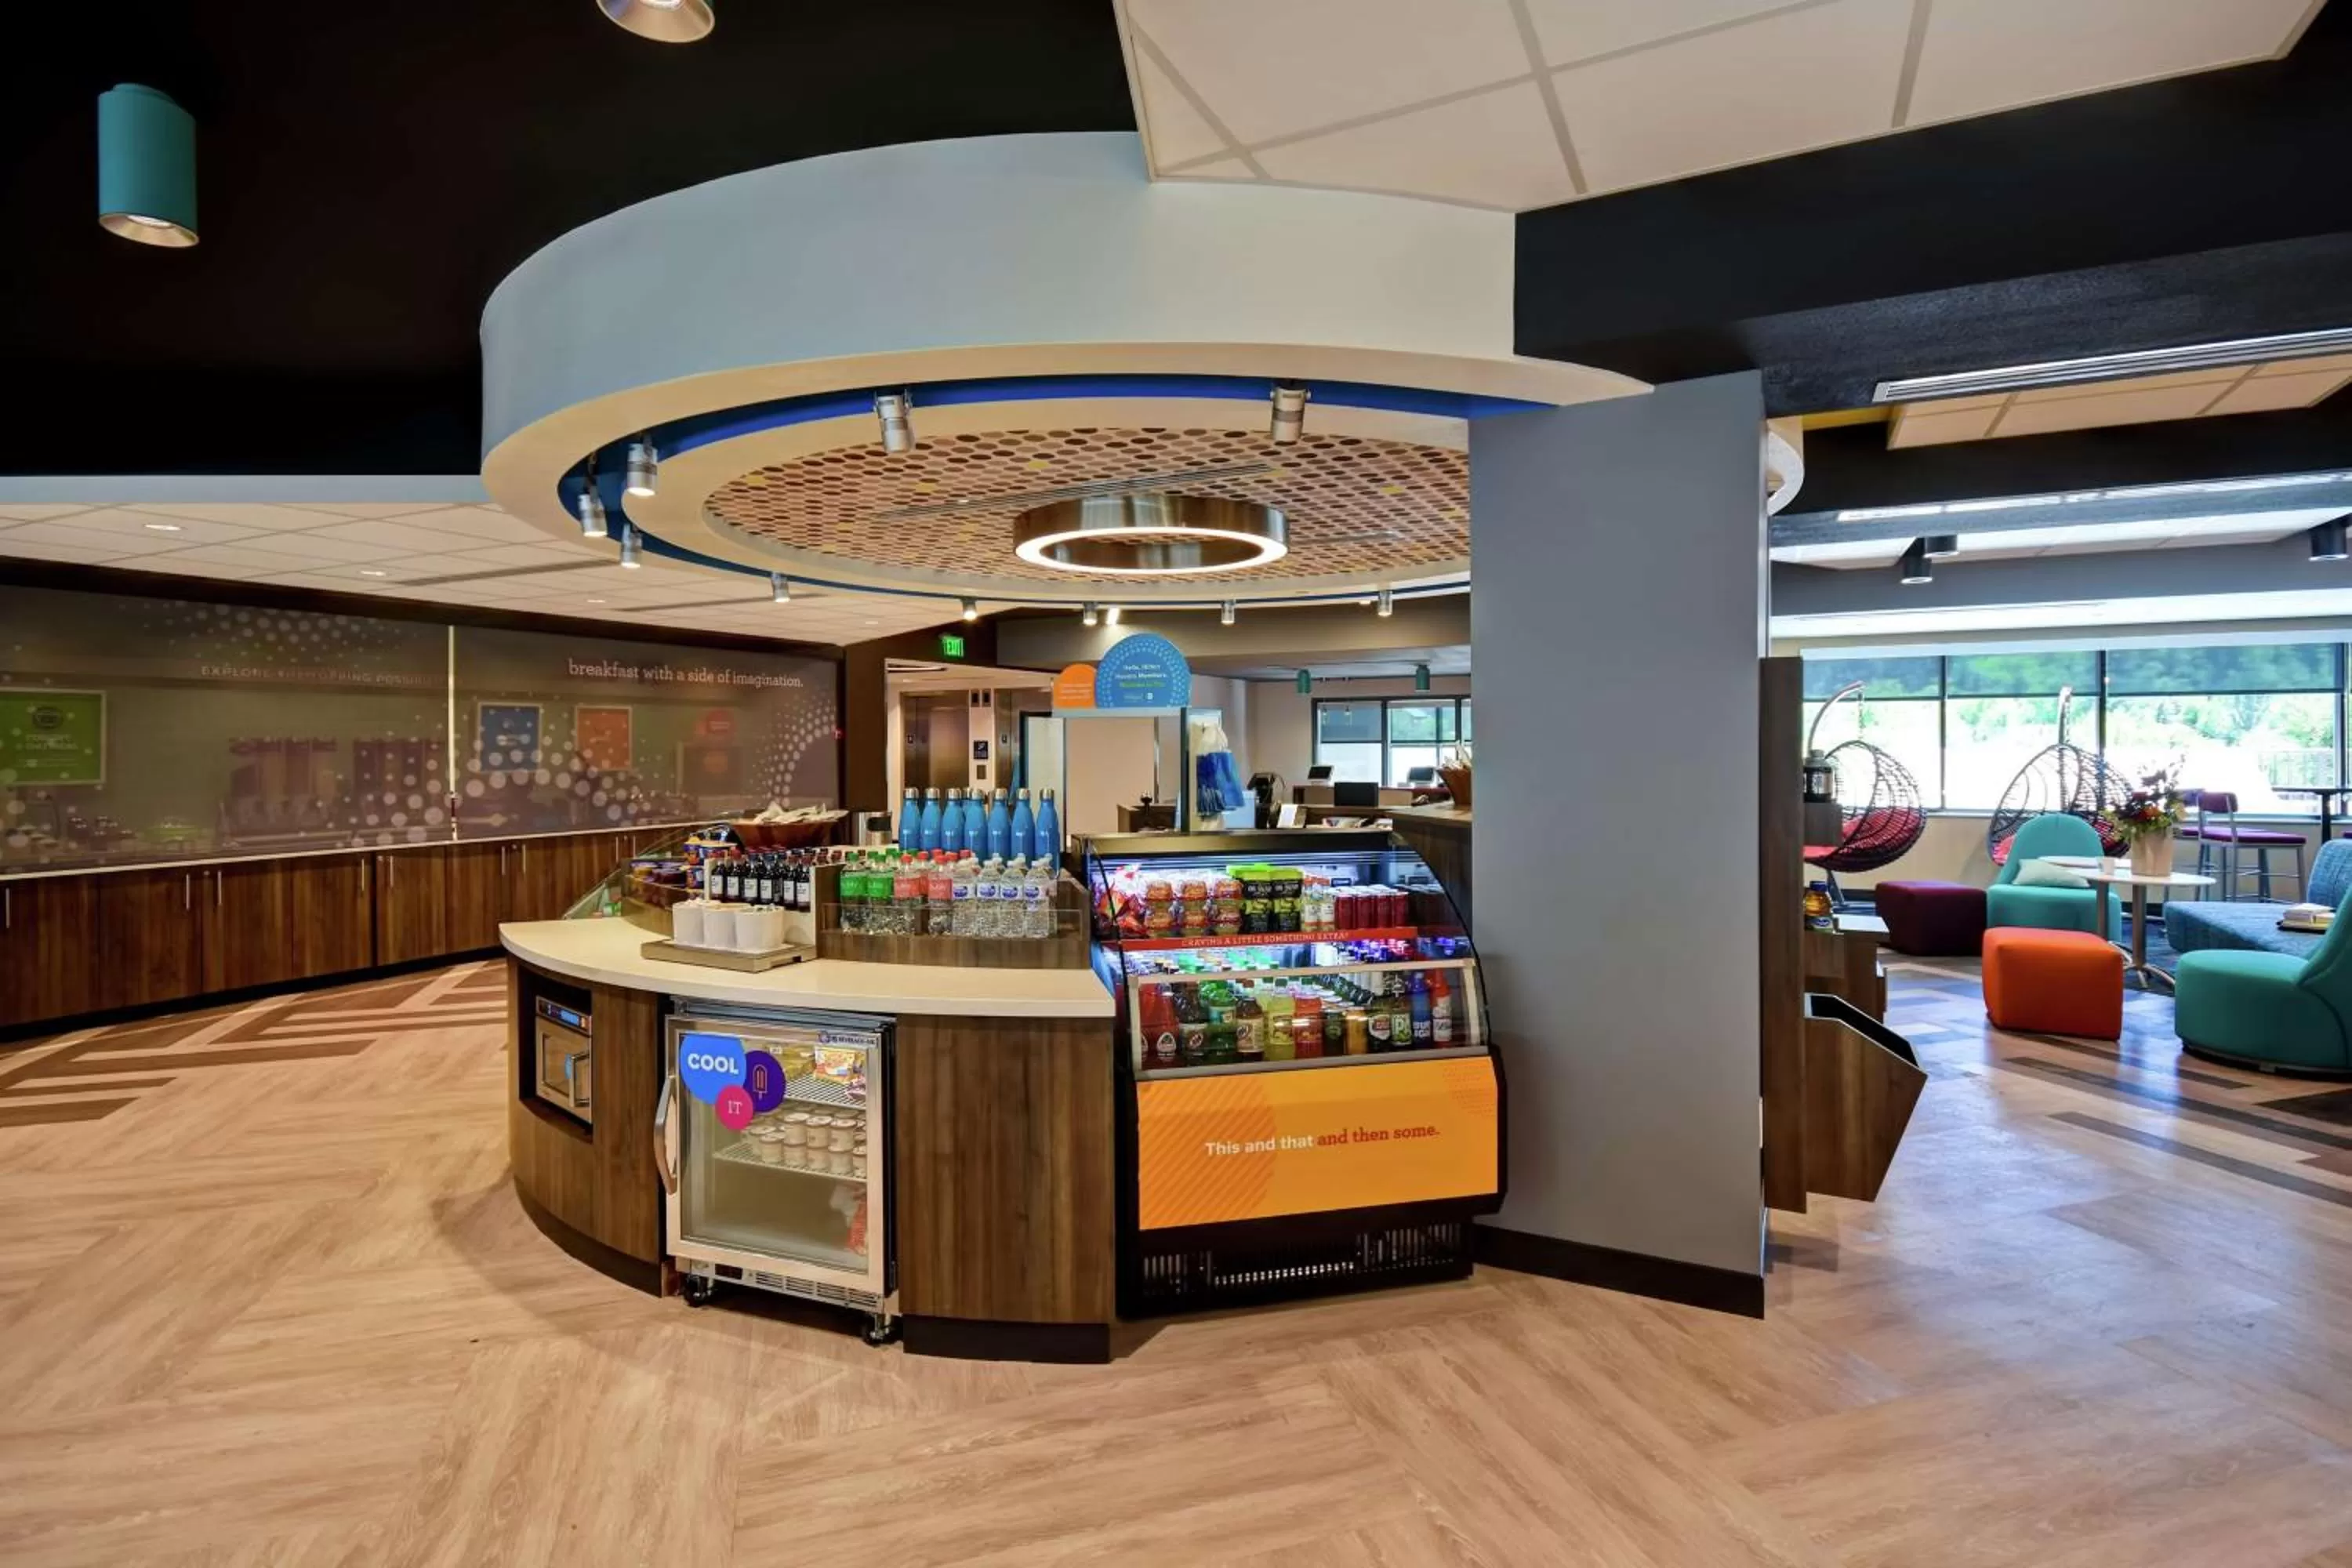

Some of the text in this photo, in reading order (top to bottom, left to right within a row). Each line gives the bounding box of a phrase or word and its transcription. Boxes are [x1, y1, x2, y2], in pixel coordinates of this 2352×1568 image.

[945, 637, 964, 656] EXIT
[569, 659, 804, 688] breakfast with a side of imagination.
[1181, 938, 1222, 947] CRAVING
[1233, 936, 1262, 945] LITTLE
[1264, 934, 1315, 943] SOMETHING
[688, 1053, 739, 1075] COOL
[728, 1100, 742, 1115] IT
[1205, 1125, 1439, 1156] This and that and then some.
